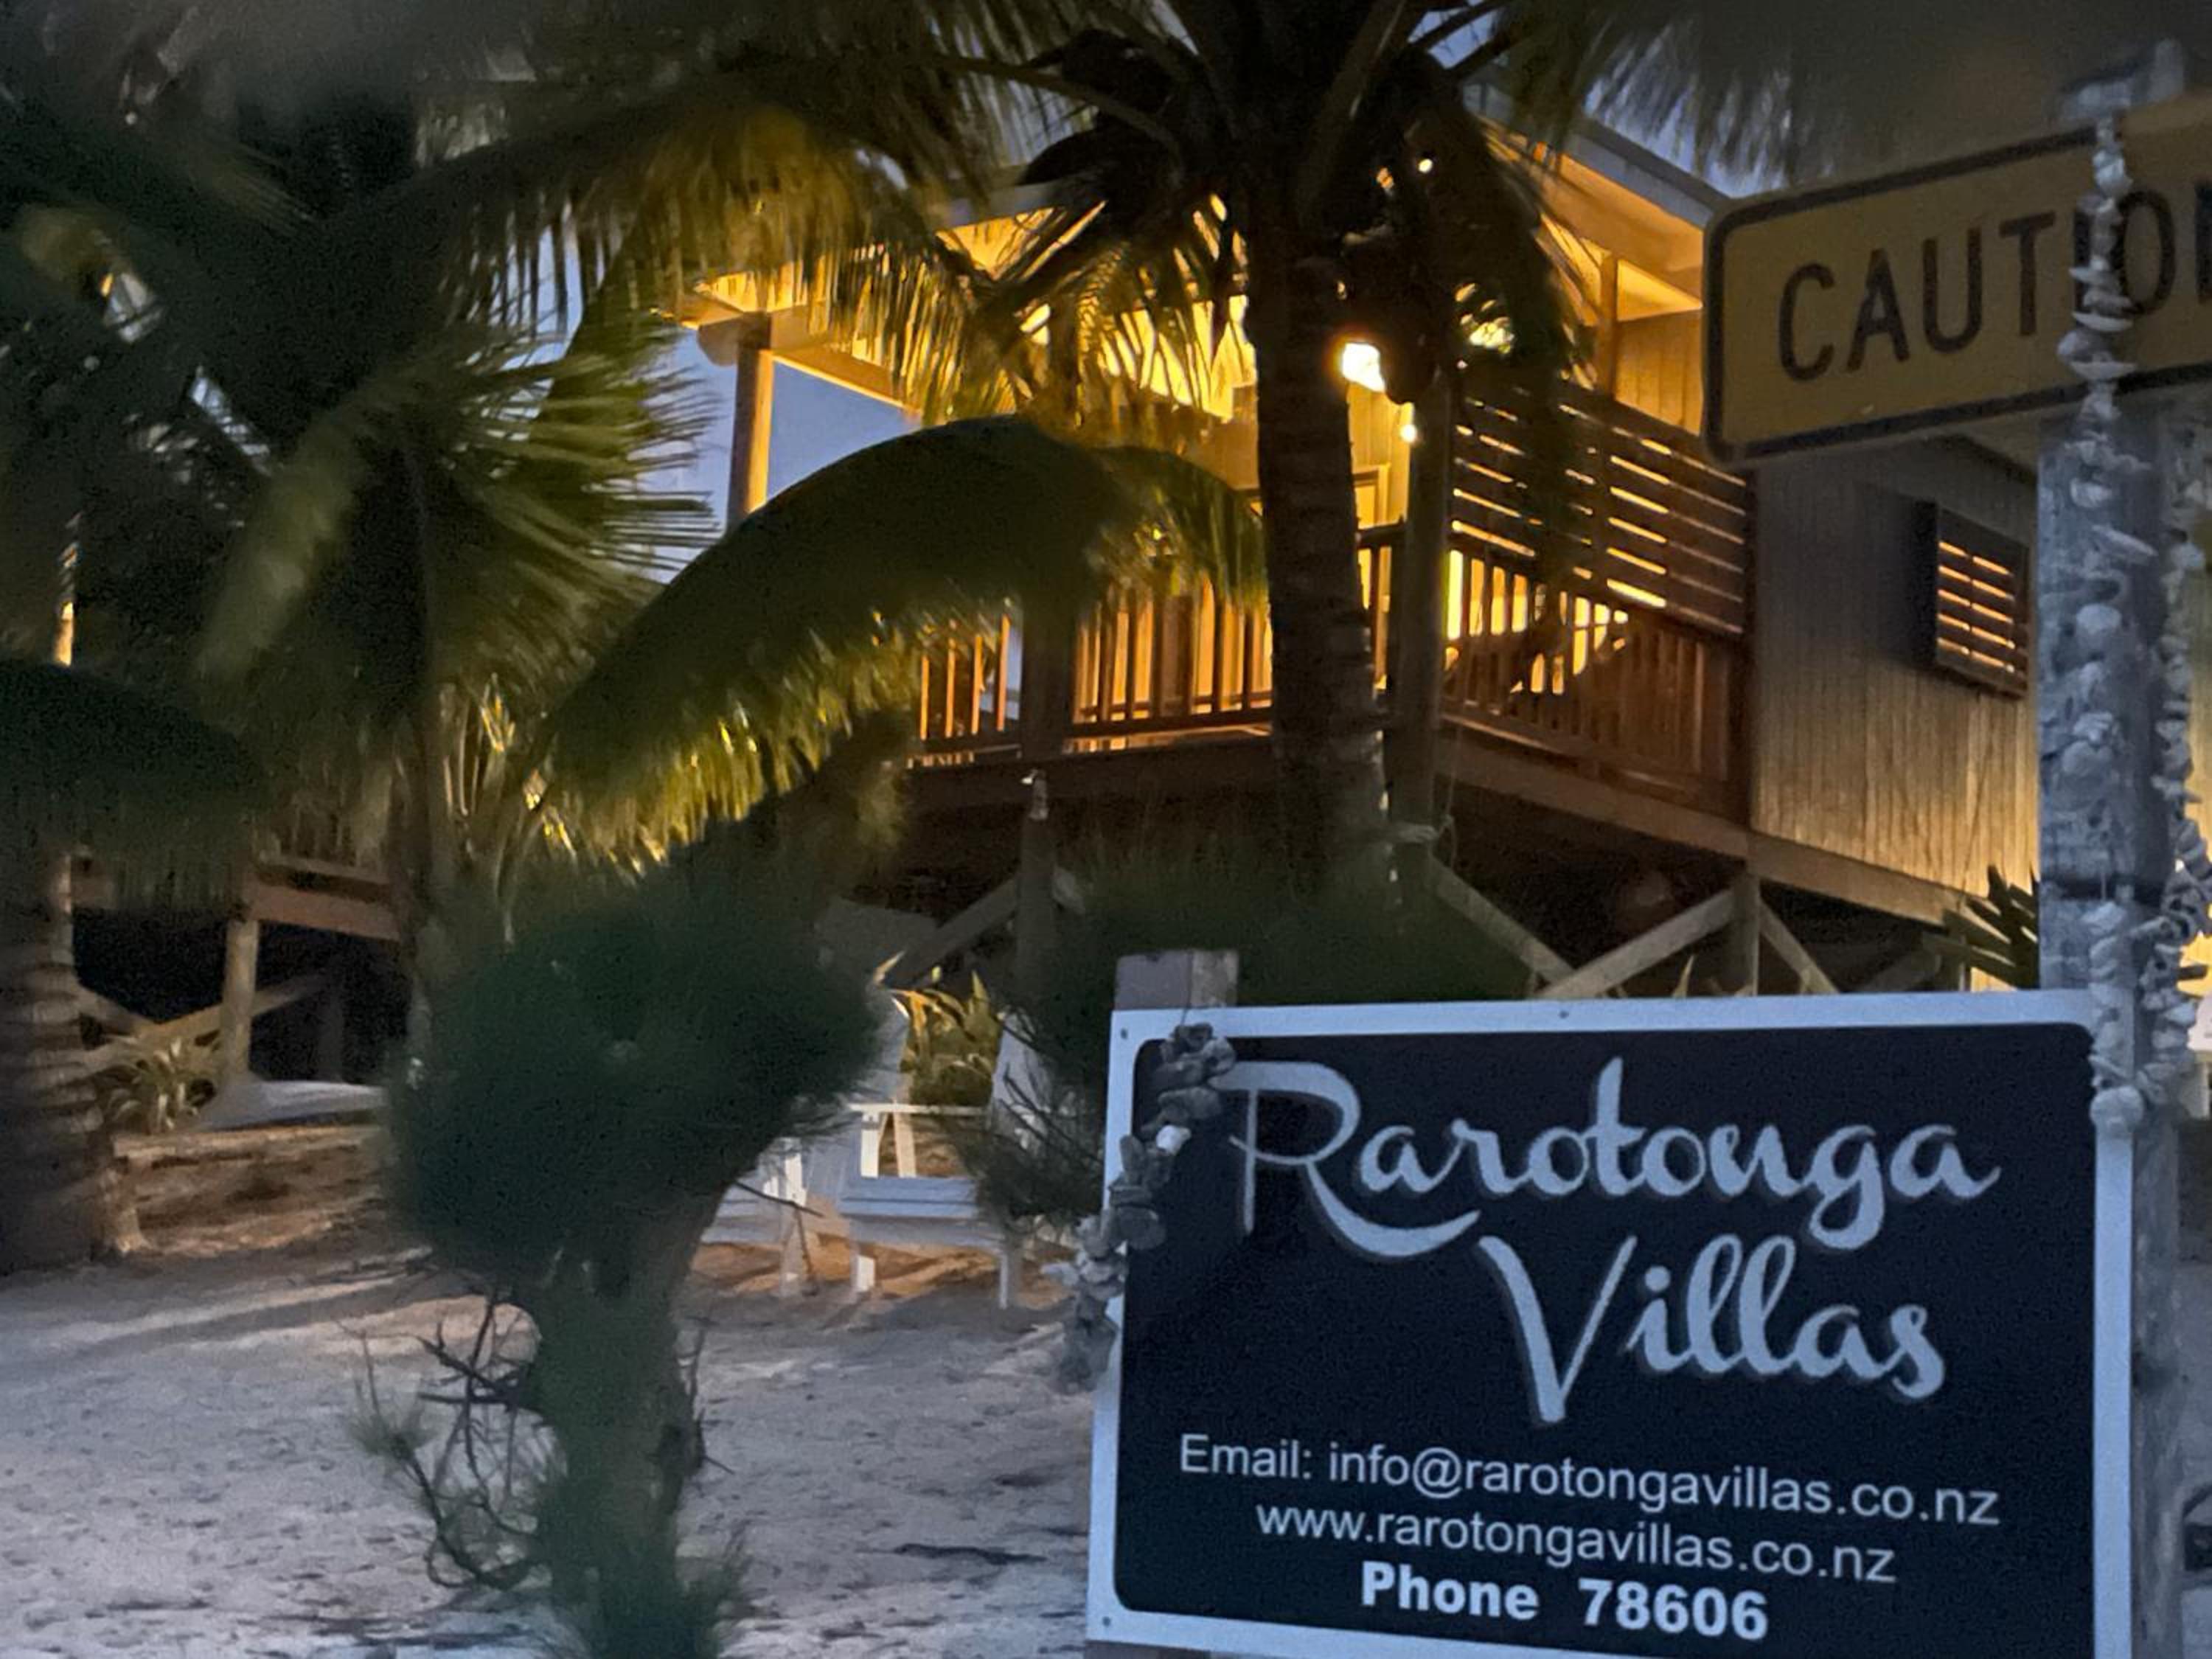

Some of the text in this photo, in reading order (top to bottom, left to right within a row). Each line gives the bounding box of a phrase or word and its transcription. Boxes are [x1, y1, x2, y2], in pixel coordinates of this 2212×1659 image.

[1778, 175, 2212, 381] CAUTIO
[1211, 1057, 2001, 1256] Rarotonga
[1479, 1234, 1945, 1423] Villas
[1180, 1434, 2000, 1525] Email: info@rarotongavillas.co.nz
[1256, 1504, 1896, 1583] www.rarotongavillas.co.nz
[1361, 1560, 1768, 1641] Phone 78606
